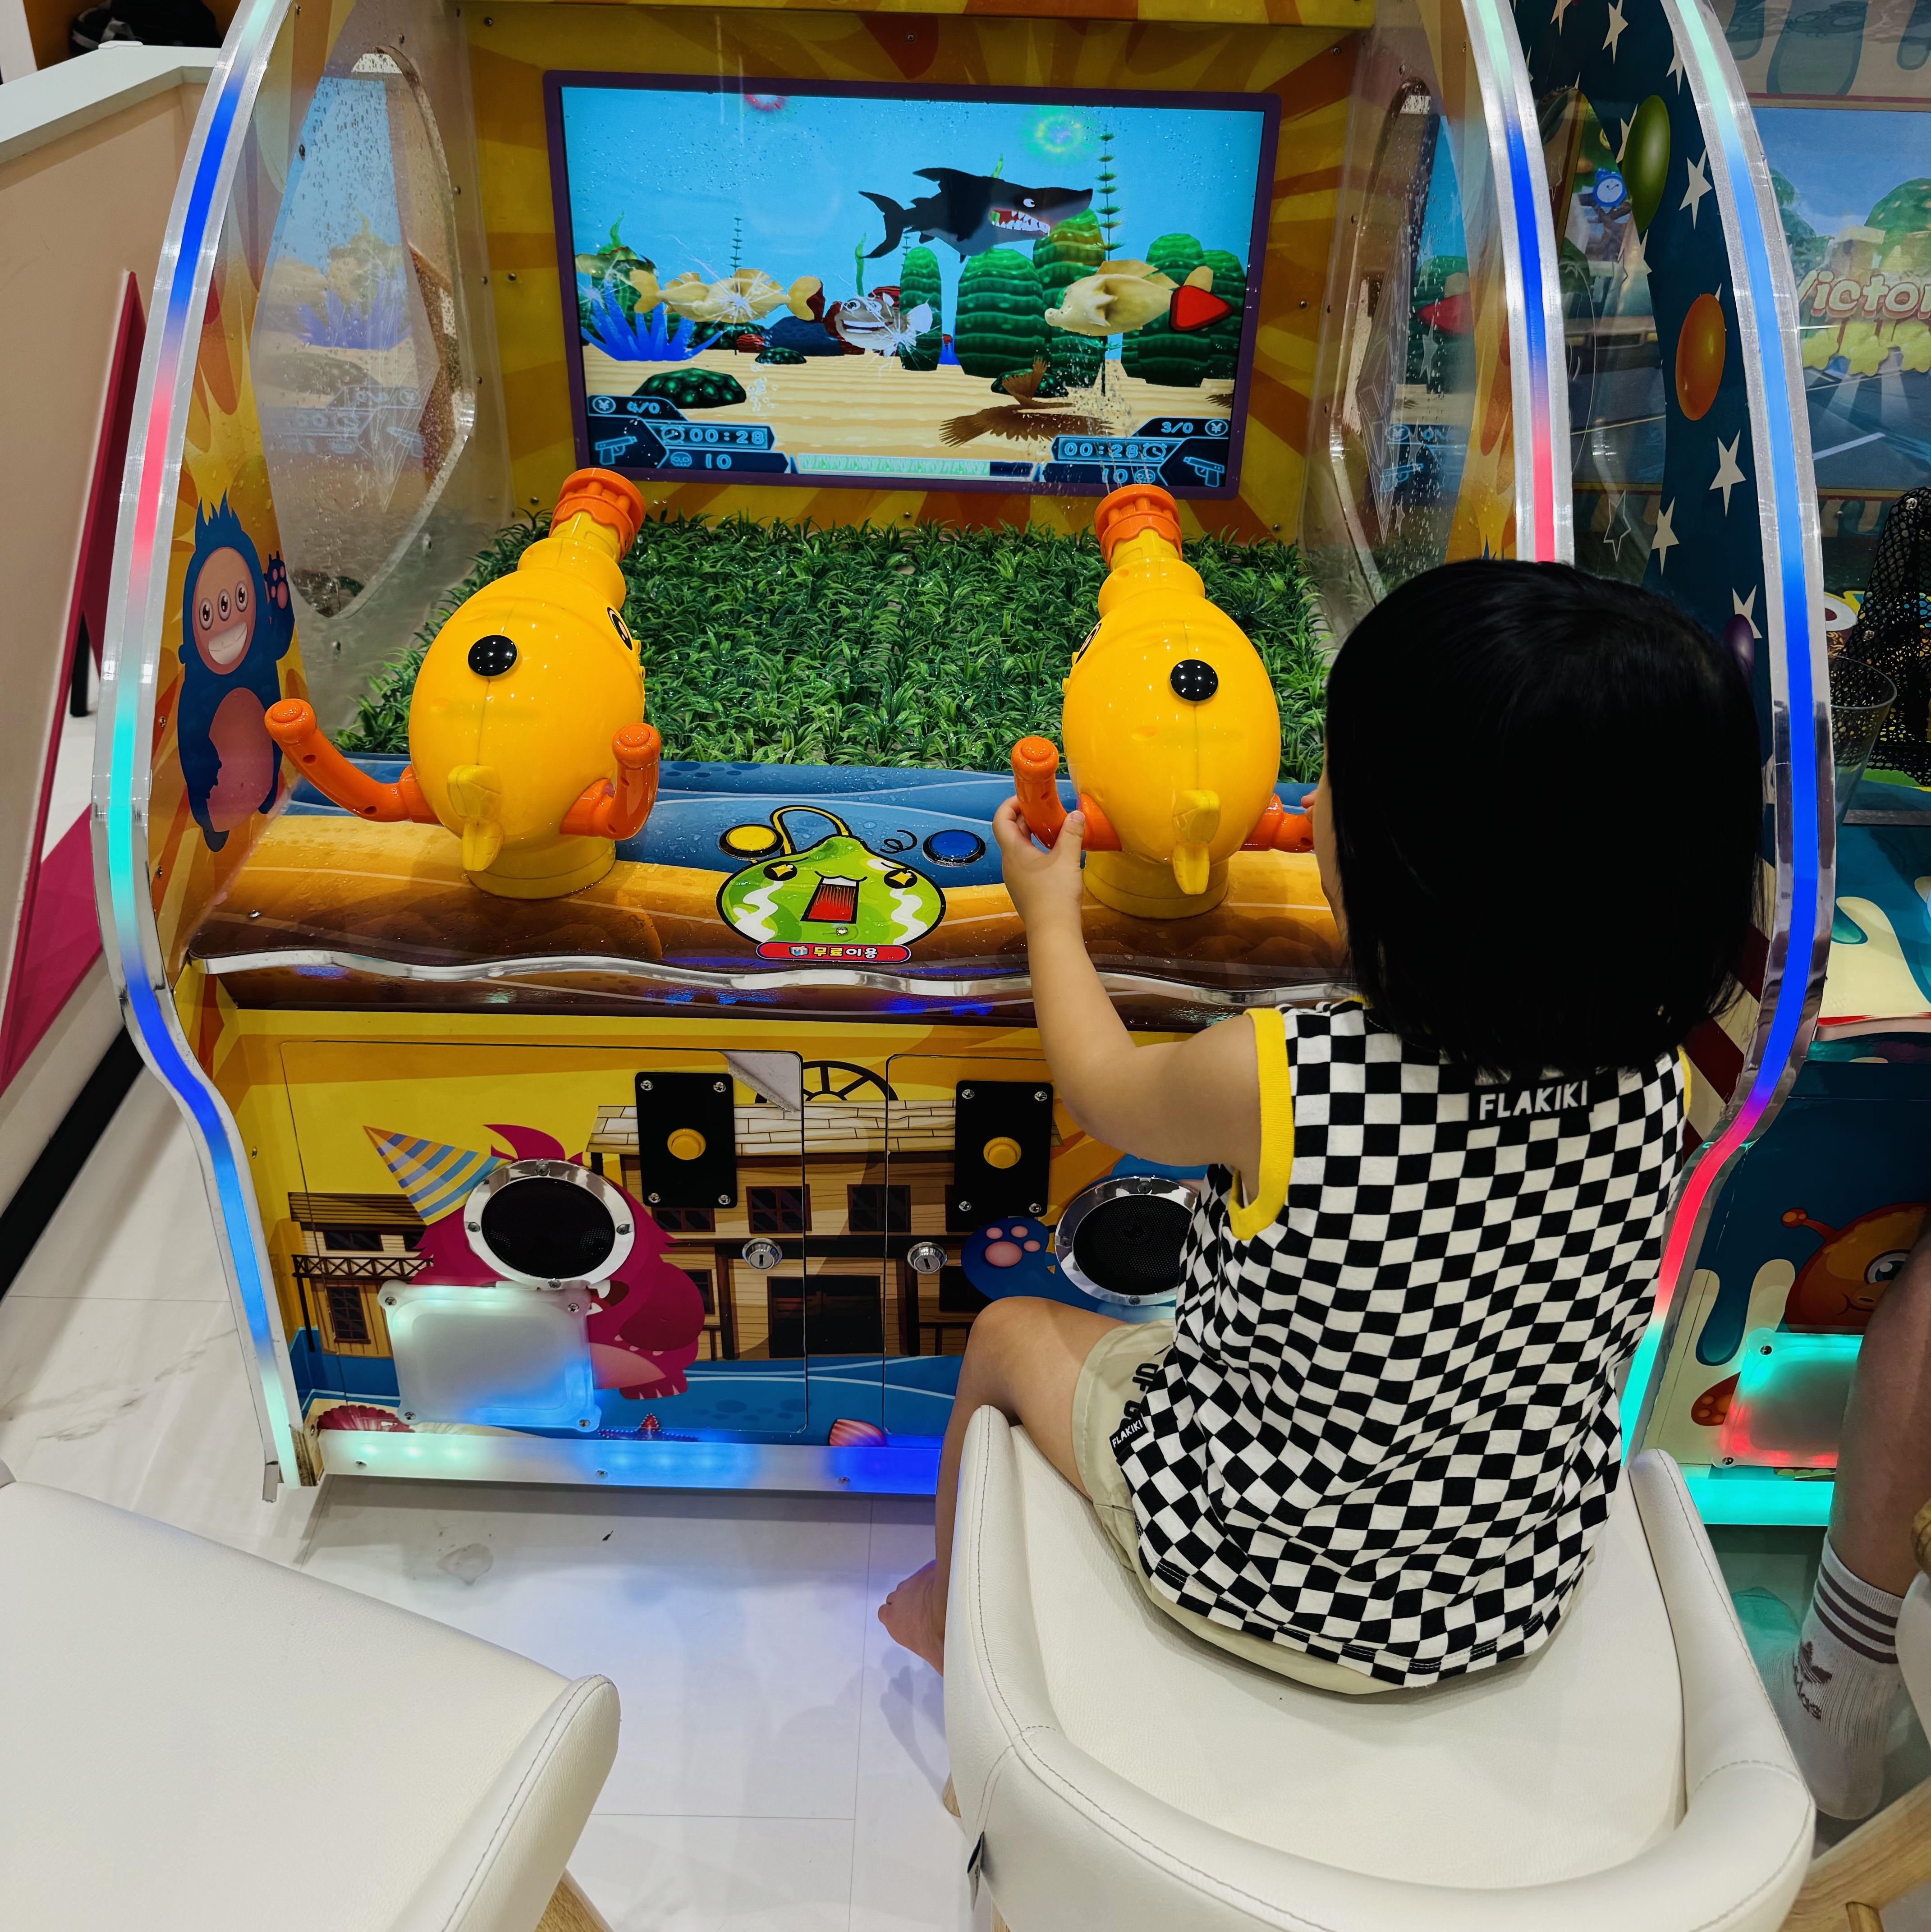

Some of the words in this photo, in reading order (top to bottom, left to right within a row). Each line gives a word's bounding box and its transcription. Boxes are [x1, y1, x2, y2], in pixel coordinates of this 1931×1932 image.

[1161, 422, 1193, 434] 3/0
[689, 428, 764, 445] 00:28
[1064, 442, 1138, 459] 00:28
[705, 453, 732, 469] 10
[1102, 468, 1128, 484] 10
[813, 946, 877, 959] 무료이용
[1479, 1080, 1587, 1120] FLAKIKI
[1112, 1419, 1143, 1448] FLAKIKI
